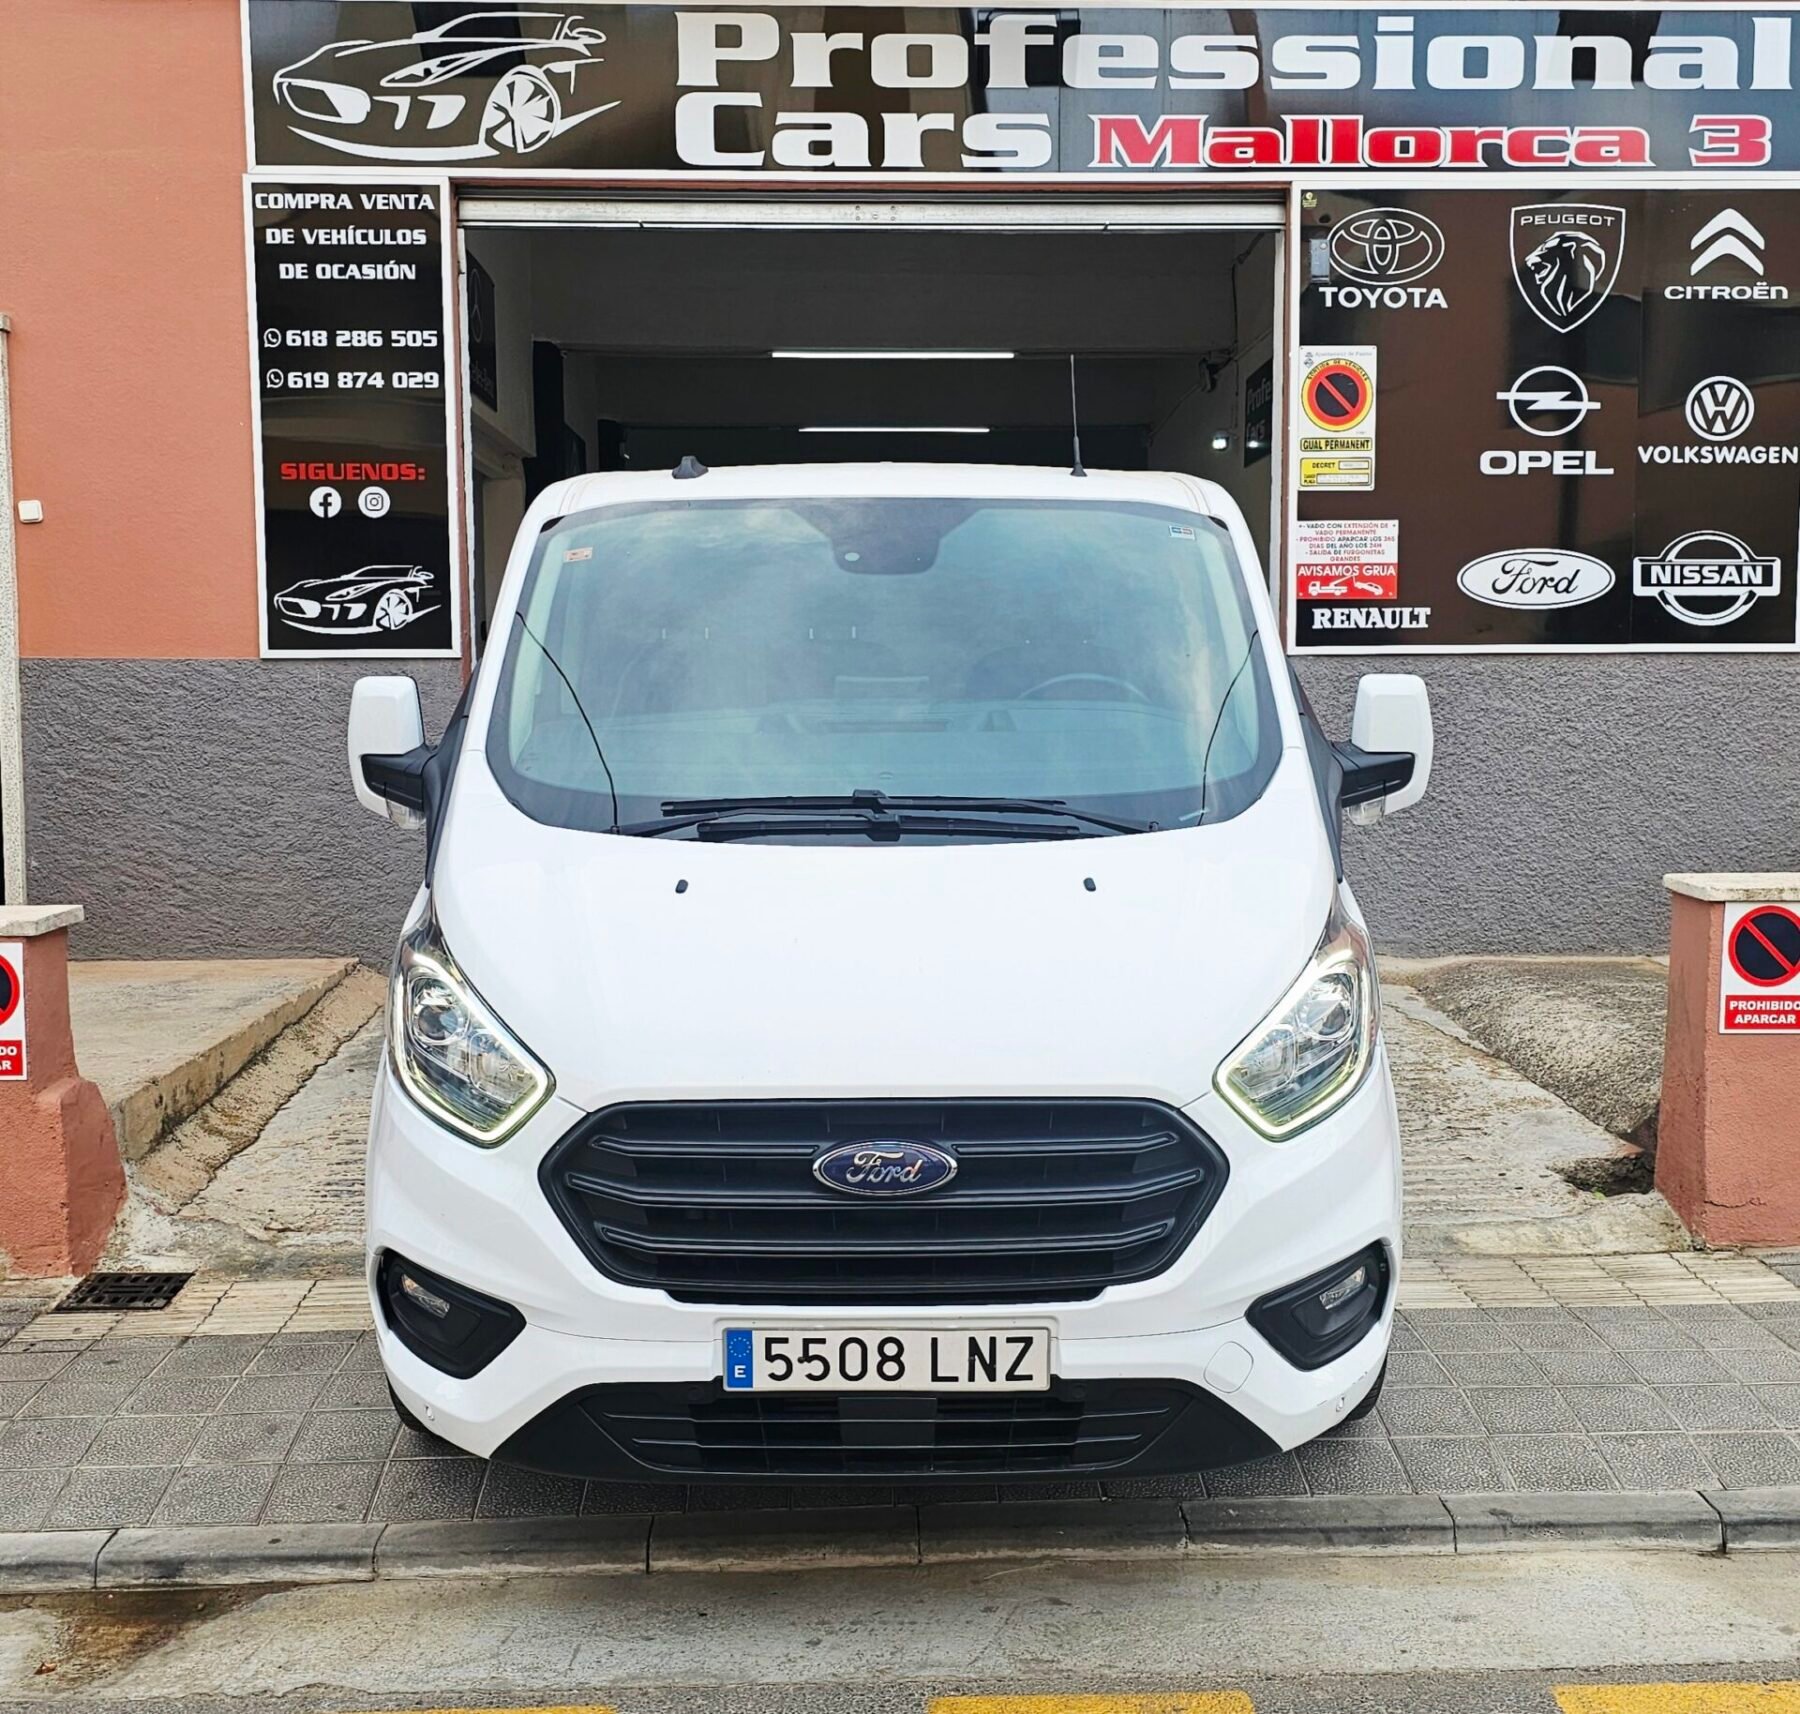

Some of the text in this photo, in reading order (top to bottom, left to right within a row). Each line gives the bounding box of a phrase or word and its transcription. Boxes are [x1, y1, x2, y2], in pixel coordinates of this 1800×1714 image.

[674, 12, 1794, 90] Professional
[675, 92, 1773, 168] Cars Mallorca 3
[255, 193, 436, 211] COMPRA VENTA
[1520, 213, 1616, 227] PEUGEOT
[265, 225, 427, 246] DE VEHÍCULOS
[279, 260, 416, 281] DE OCASIÓN
[1318, 286, 1448, 310] TOYOTA
[286, 329, 438, 348] 618 286 505
[287, 371, 440, 389] 619 874 029
[1303, 439, 1370, 450] GUAL PERMANENT
[1637, 445, 1799, 465] VOLKSWAGEN
[280, 461, 427, 482] SIGUENOS:
[1479, 449, 1615, 476] OPEL
[1298, 565, 1397, 577] AVISAMOS GRUA
[1491, 558, 1581, 595] Ford
[1650, 564, 1763, 585] NISSAN
[1311, 607, 1431, 630] RENAULT
[1730, 1000, 1800, 1011] PROHIBIDO
[1734, 1014, 1796, 1024] APARCAR
[845, 1150, 924, 1184] Ford
[764, 1336, 1034, 1382] 5508 LNZ
[734, 1365, 746, 1378] E
